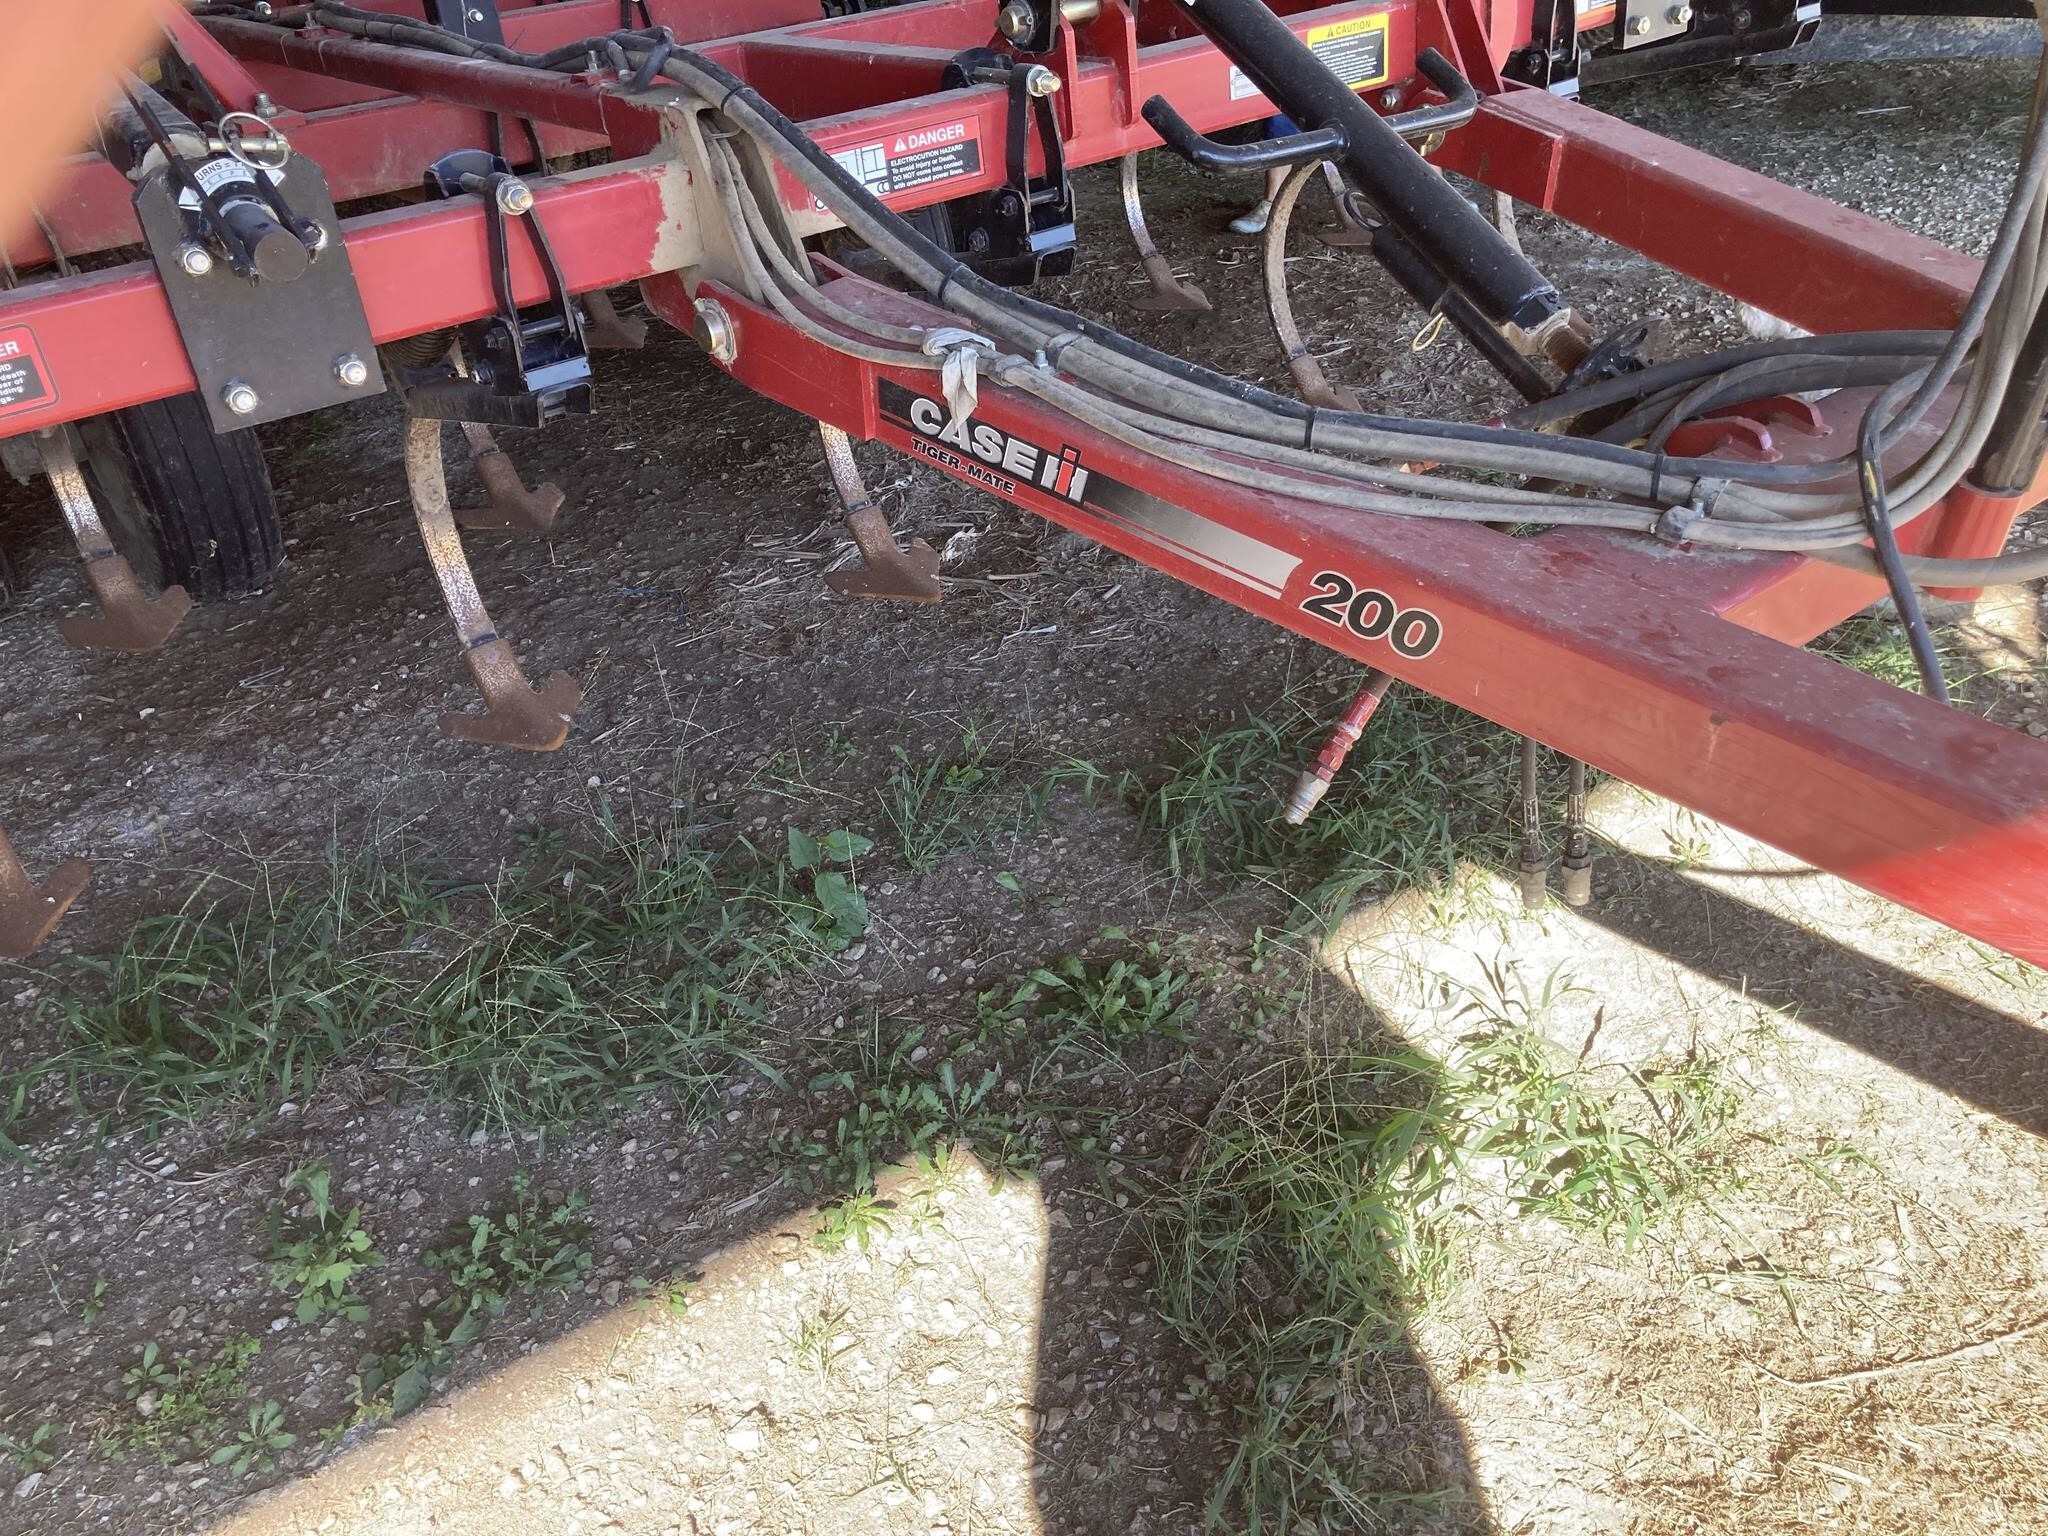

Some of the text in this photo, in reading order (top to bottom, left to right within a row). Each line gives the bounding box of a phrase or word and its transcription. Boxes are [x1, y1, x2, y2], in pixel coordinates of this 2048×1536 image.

[1335, 20, 1371, 35] CAUTION
[908, 124, 965, 149] DANGER
[890, 144, 964, 167] ELECTROCUTION HAZARD
[196, 162, 223, 181] URNS
[893, 168, 965, 190] with overhead power lines.
[899, 164, 915, 173] avoid
[903, 171, 915, 180] NOT
[916, 168, 932, 176] come
[943, 160, 963, 169] contact
[14, 377, 23, 385] of
[910, 397, 1039, 482] CASE
[911, 437, 1016, 496] TIGER-MATE
[1298, 570, 1444, 660] 200
